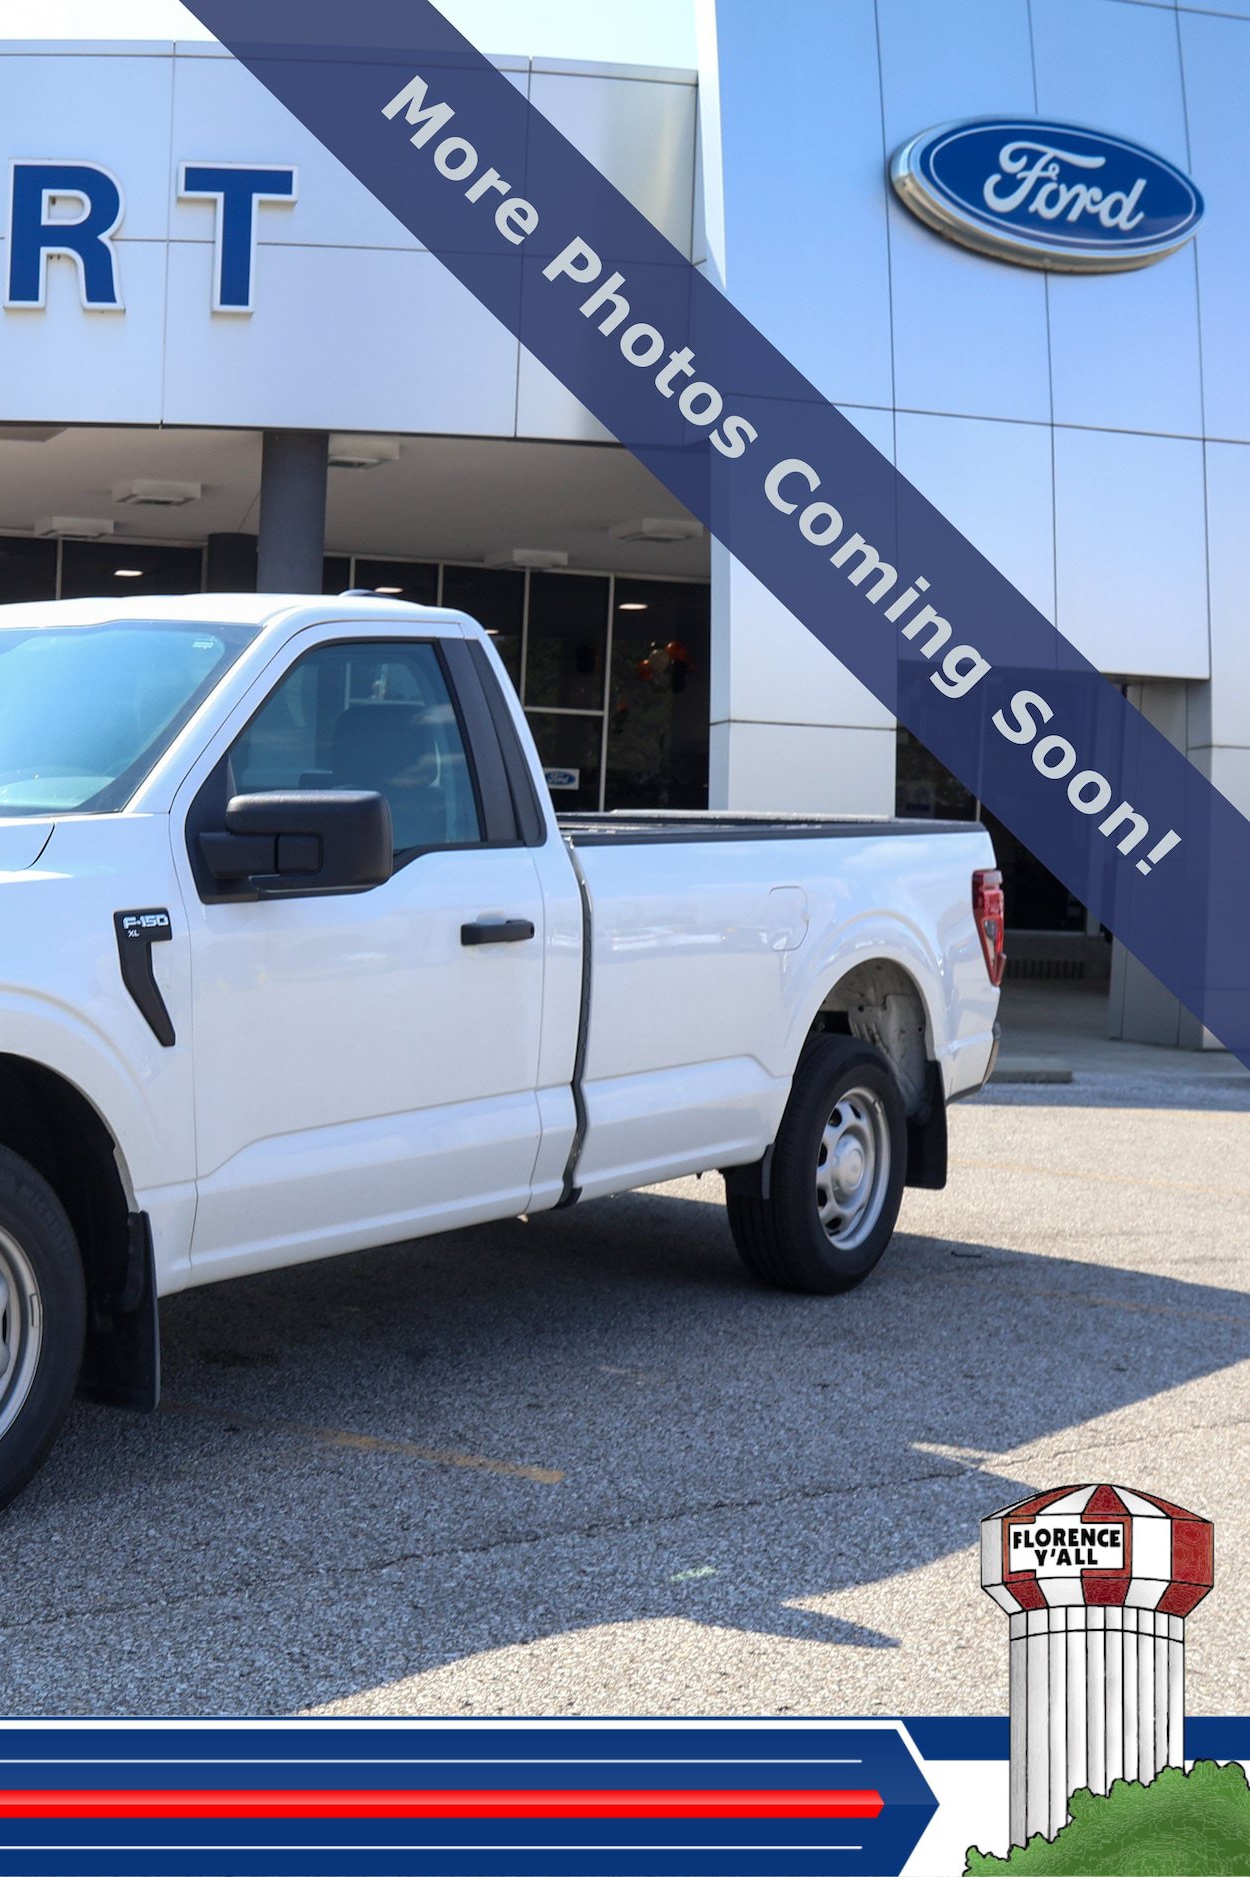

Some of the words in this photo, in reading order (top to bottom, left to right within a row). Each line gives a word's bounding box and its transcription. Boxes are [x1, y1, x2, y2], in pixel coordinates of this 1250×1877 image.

[983, 141, 1147, 231] Ford
[123, 914, 169, 929] F-150
[128, 929, 140, 938] XL
